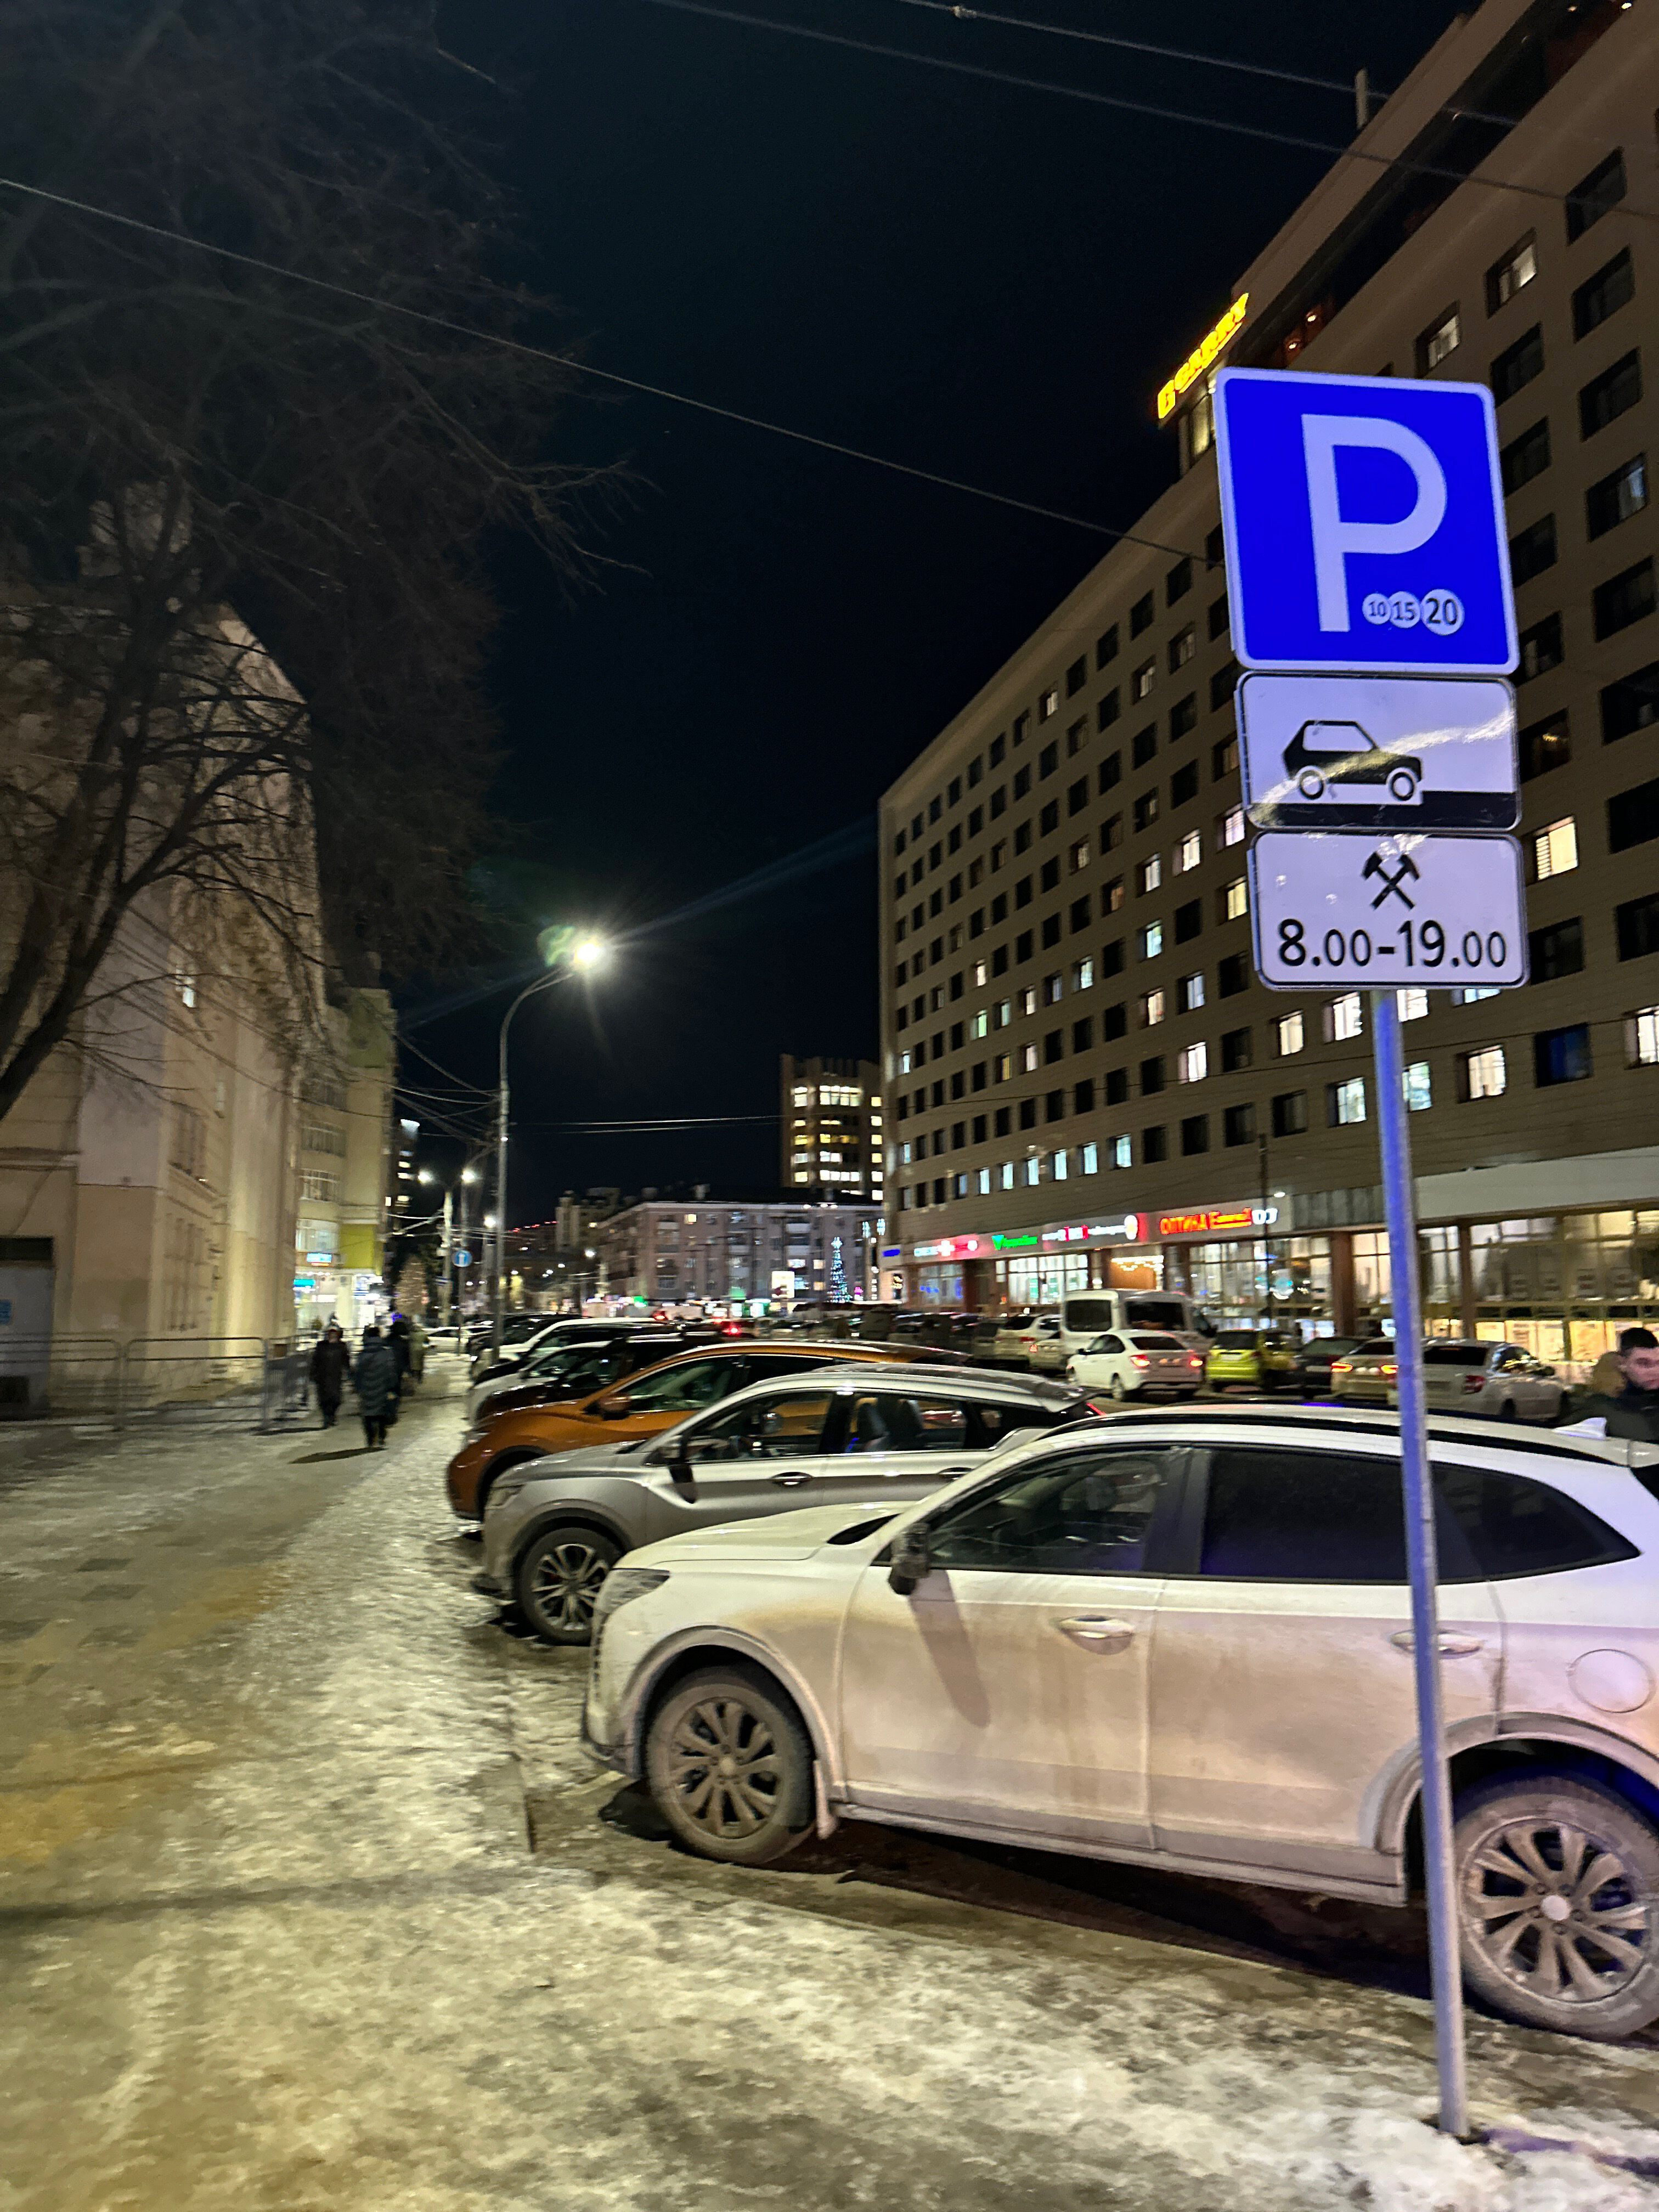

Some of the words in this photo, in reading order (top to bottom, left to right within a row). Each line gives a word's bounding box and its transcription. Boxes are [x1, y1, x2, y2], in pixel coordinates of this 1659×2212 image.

[1301, 413, 1448, 633] P
[1368, 600, 1387, 618] 10
[1392, 601, 1417, 621] 15
[1427, 597, 1459, 625] 20
[1277, 918, 1508, 968] 8.00-19.00
